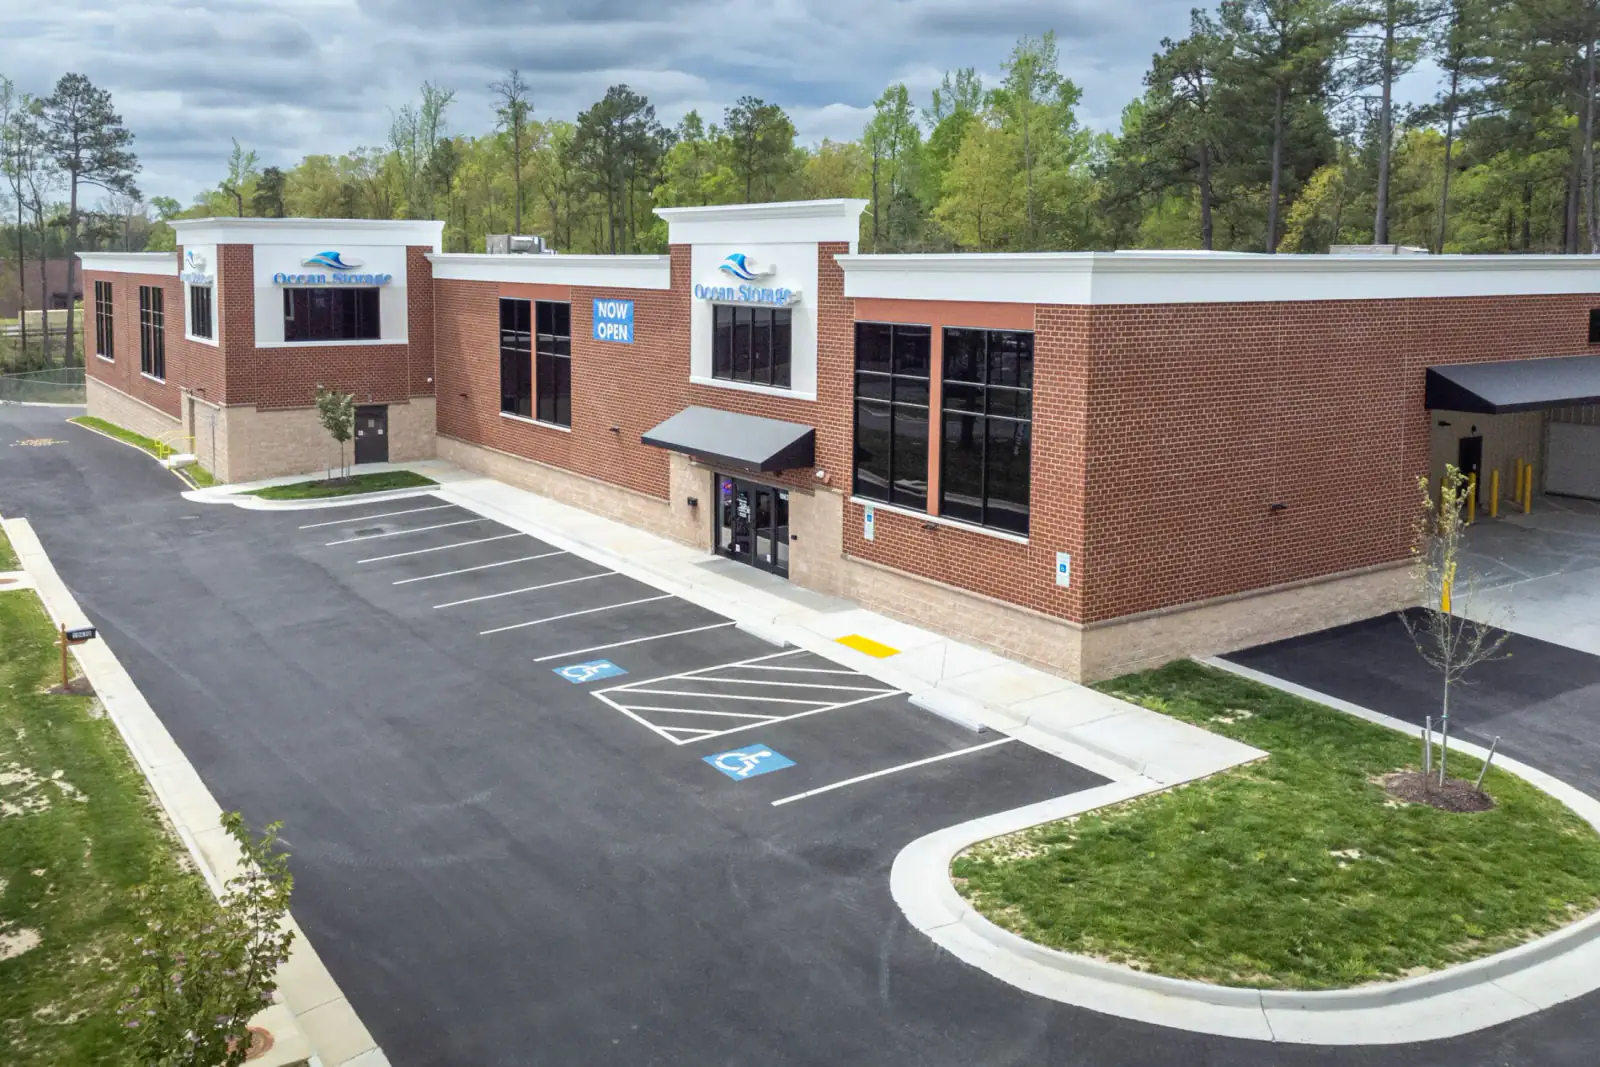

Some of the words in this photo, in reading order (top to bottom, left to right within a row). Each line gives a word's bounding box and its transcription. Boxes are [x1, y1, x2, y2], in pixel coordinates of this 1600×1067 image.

[273, 272, 326, 285] Ocean
[332, 272, 392, 288] Storage
[694, 283, 735, 301] Ocean
[739, 284, 792, 306] Storage
[598, 301, 628, 319] NOW
[598, 322, 628, 340] OPEN
